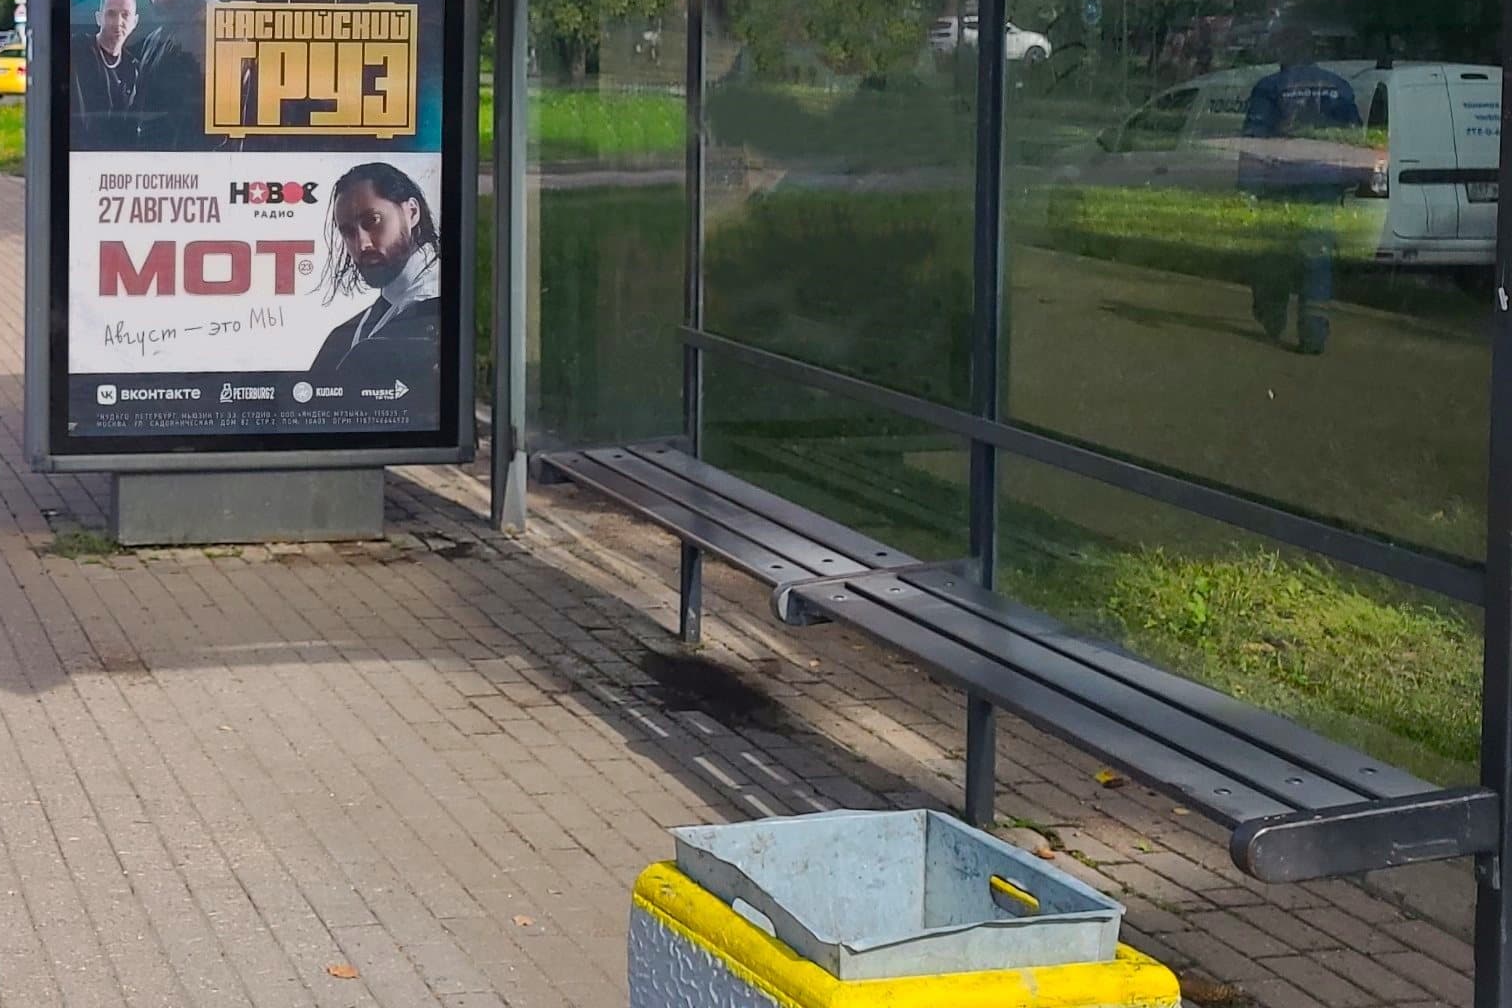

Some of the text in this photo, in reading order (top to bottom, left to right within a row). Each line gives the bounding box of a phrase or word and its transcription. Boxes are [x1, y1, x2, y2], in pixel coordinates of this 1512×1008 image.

[215, 9, 410, 41] КАСПИЙСКИЙ
[215, 41, 409, 127] ГРУЗ
[99, 174, 199, 192] ДВОР ГОСТИНКИ
[98, 196, 222, 224] 27 АВГУСТА
[254, 210, 295, 219] РАДИО
[99, 240, 316, 296] МОТ
[104, 321, 177, 357] Август
[207, 320, 242, 336] это
[249, 305, 285, 330] МЫ
[315, 387, 344, 397] KUDAGO
[361, 389, 395, 397] music
